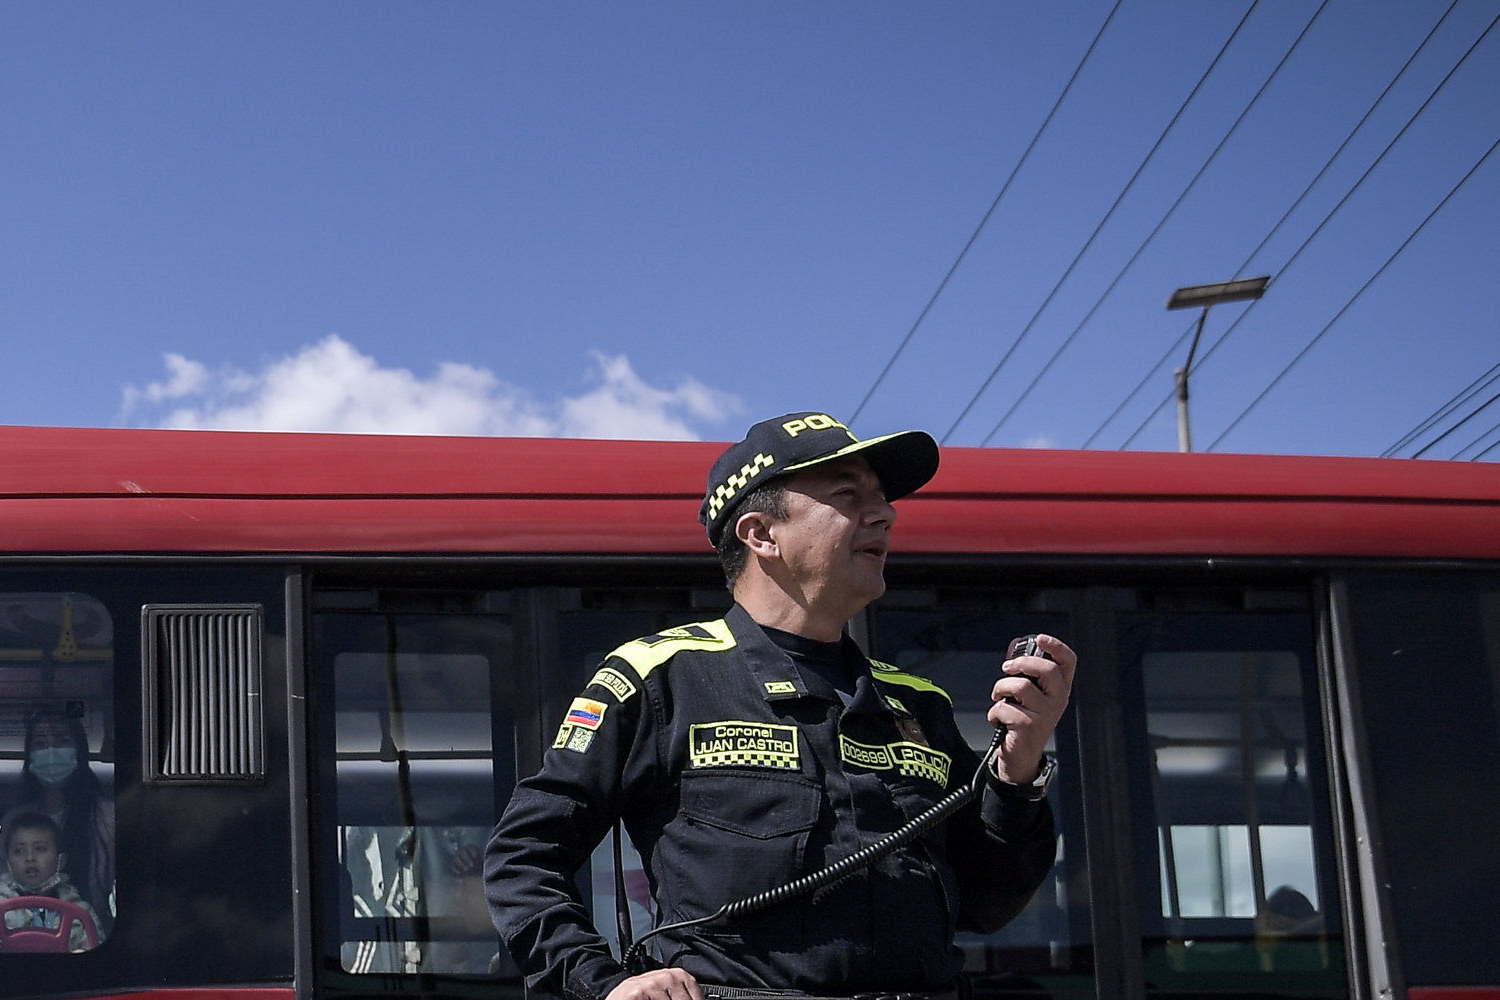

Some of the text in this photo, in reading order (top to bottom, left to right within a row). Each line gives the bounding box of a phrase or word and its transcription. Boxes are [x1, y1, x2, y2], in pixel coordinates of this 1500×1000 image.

[715, 726, 773, 738] Coronel
[696, 738, 793, 754] JUAN CASTRO
